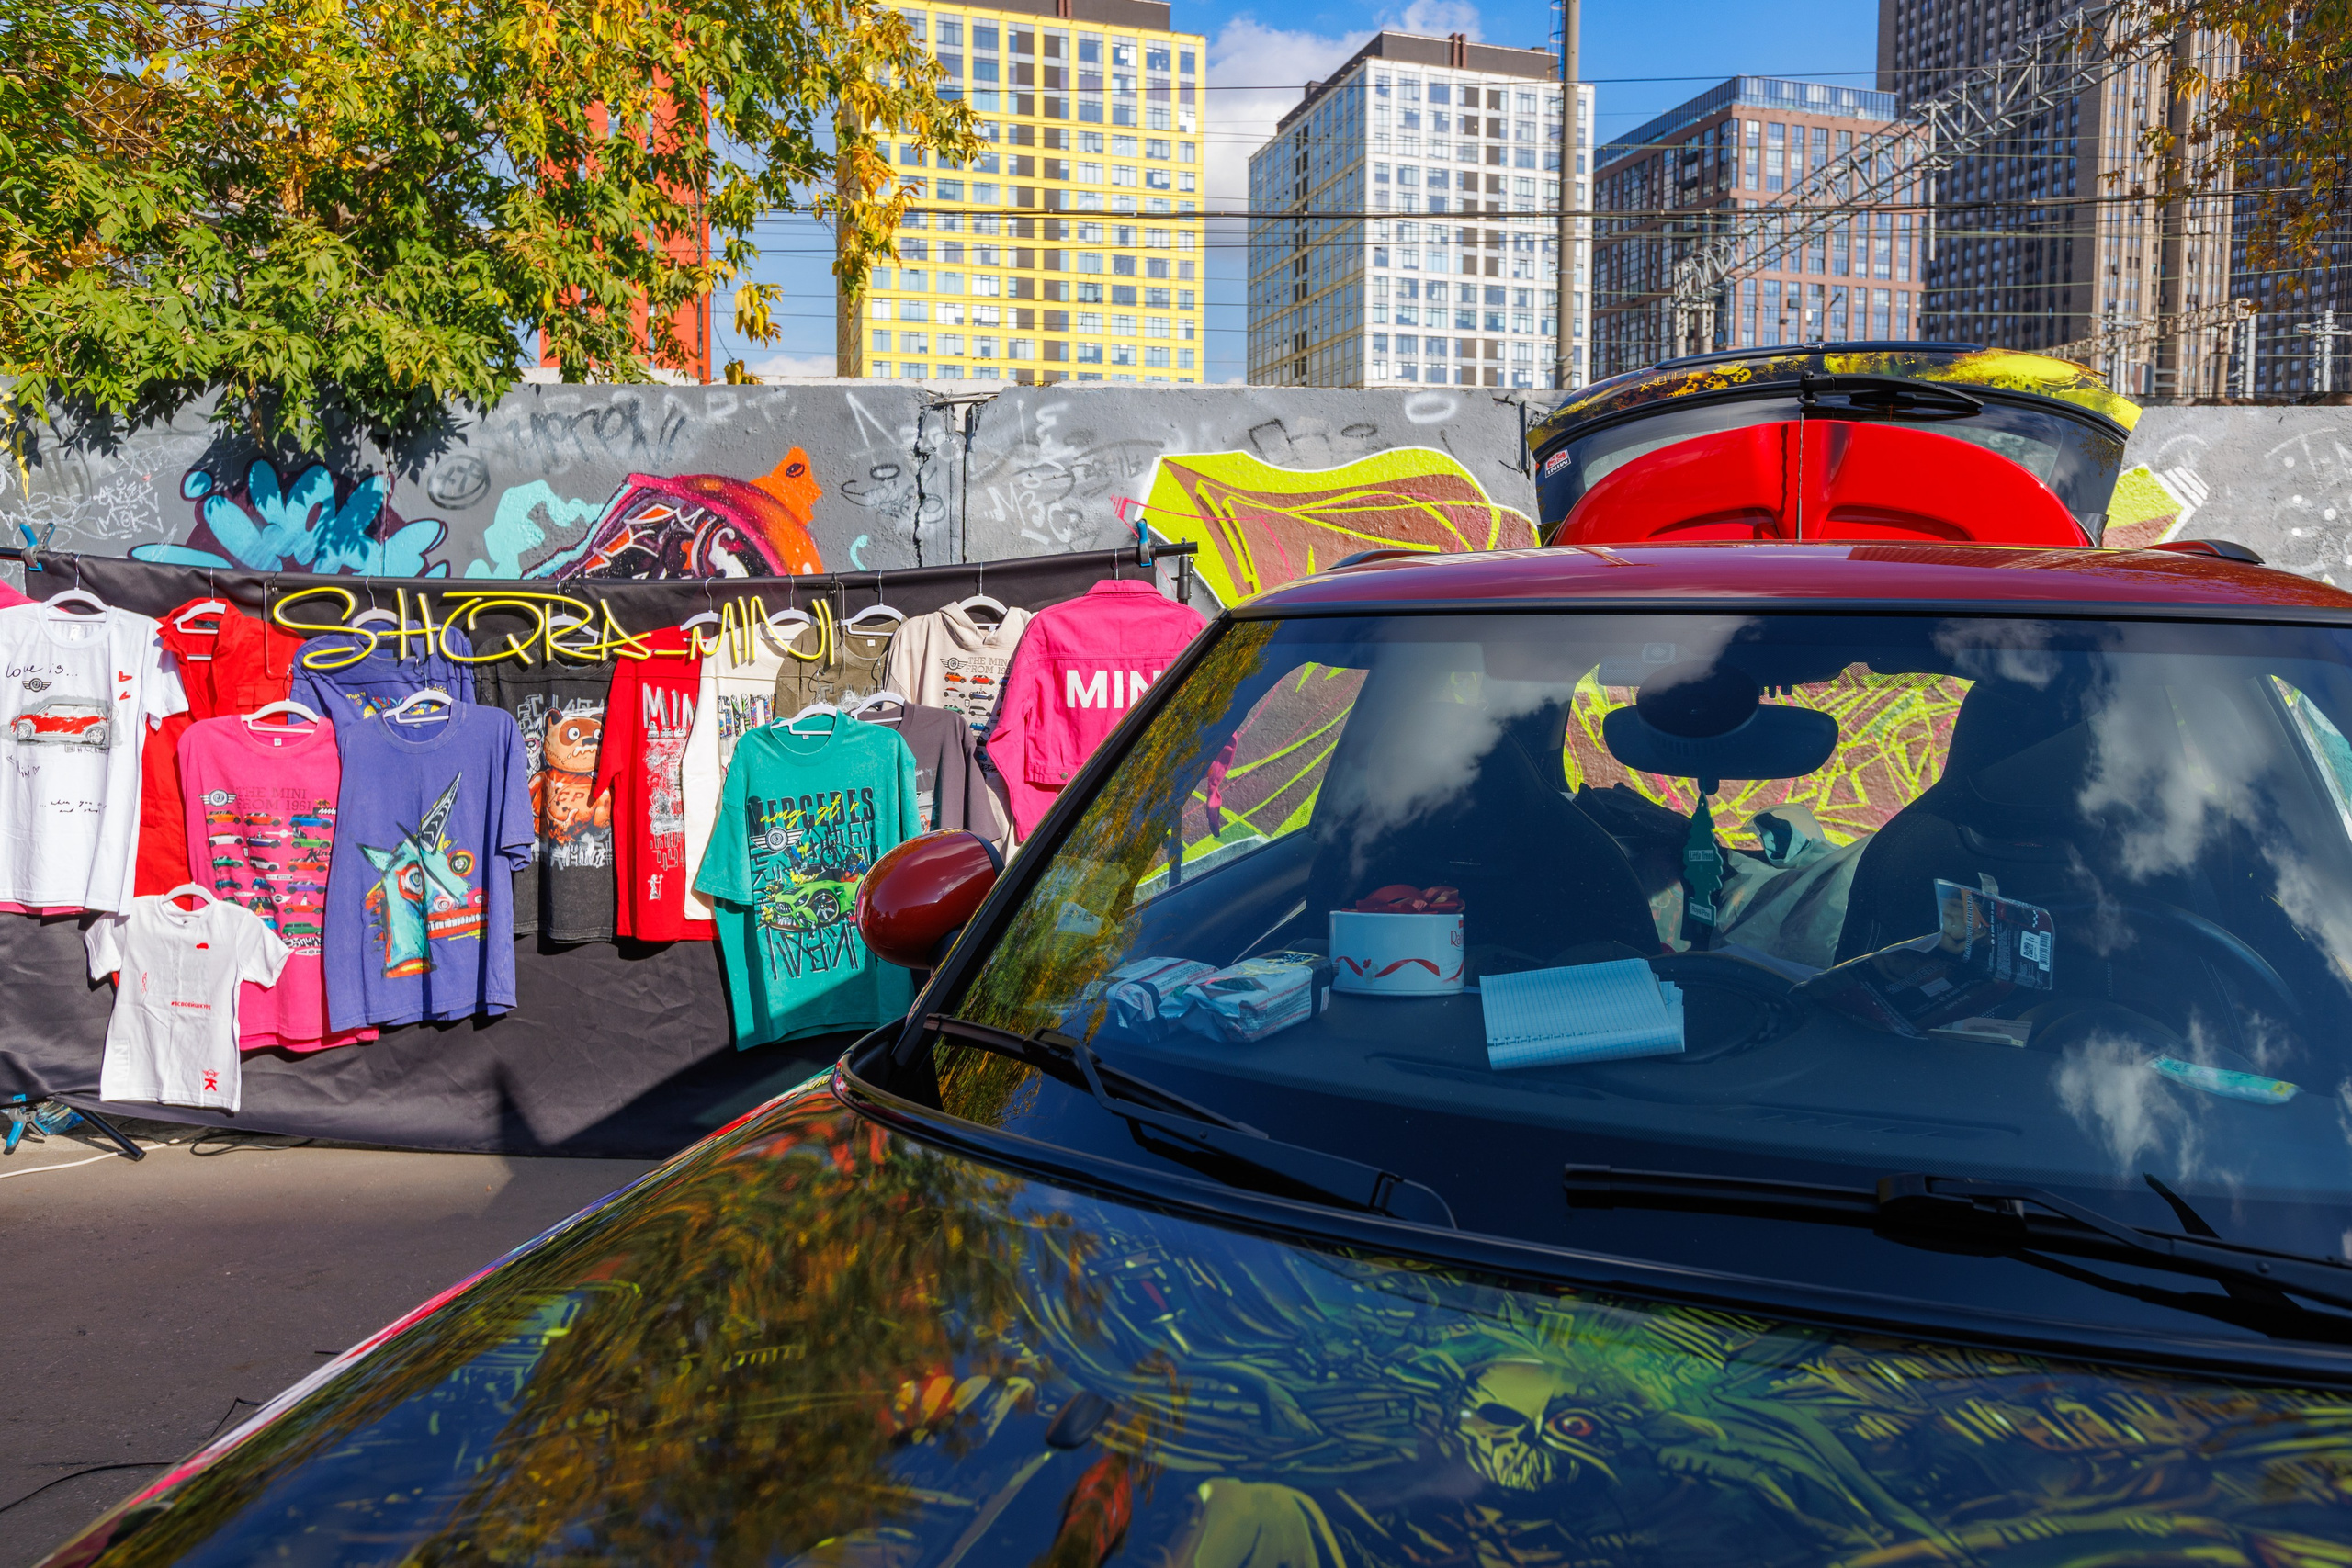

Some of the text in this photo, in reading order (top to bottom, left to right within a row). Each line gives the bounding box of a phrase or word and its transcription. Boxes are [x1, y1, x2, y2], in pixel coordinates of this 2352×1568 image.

[1546, 459, 1569, 475] MINI
[967, 657, 987, 666] THE
[964, 664, 994, 674] FROM
[235, 787, 308, 799] THE MINI
[235, 797, 311, 811] FROM 1961
[747, 786, 876, 837] MERCEDES
[760, 809, 806, 829] amg
[814, 794, 842, 826] gt
